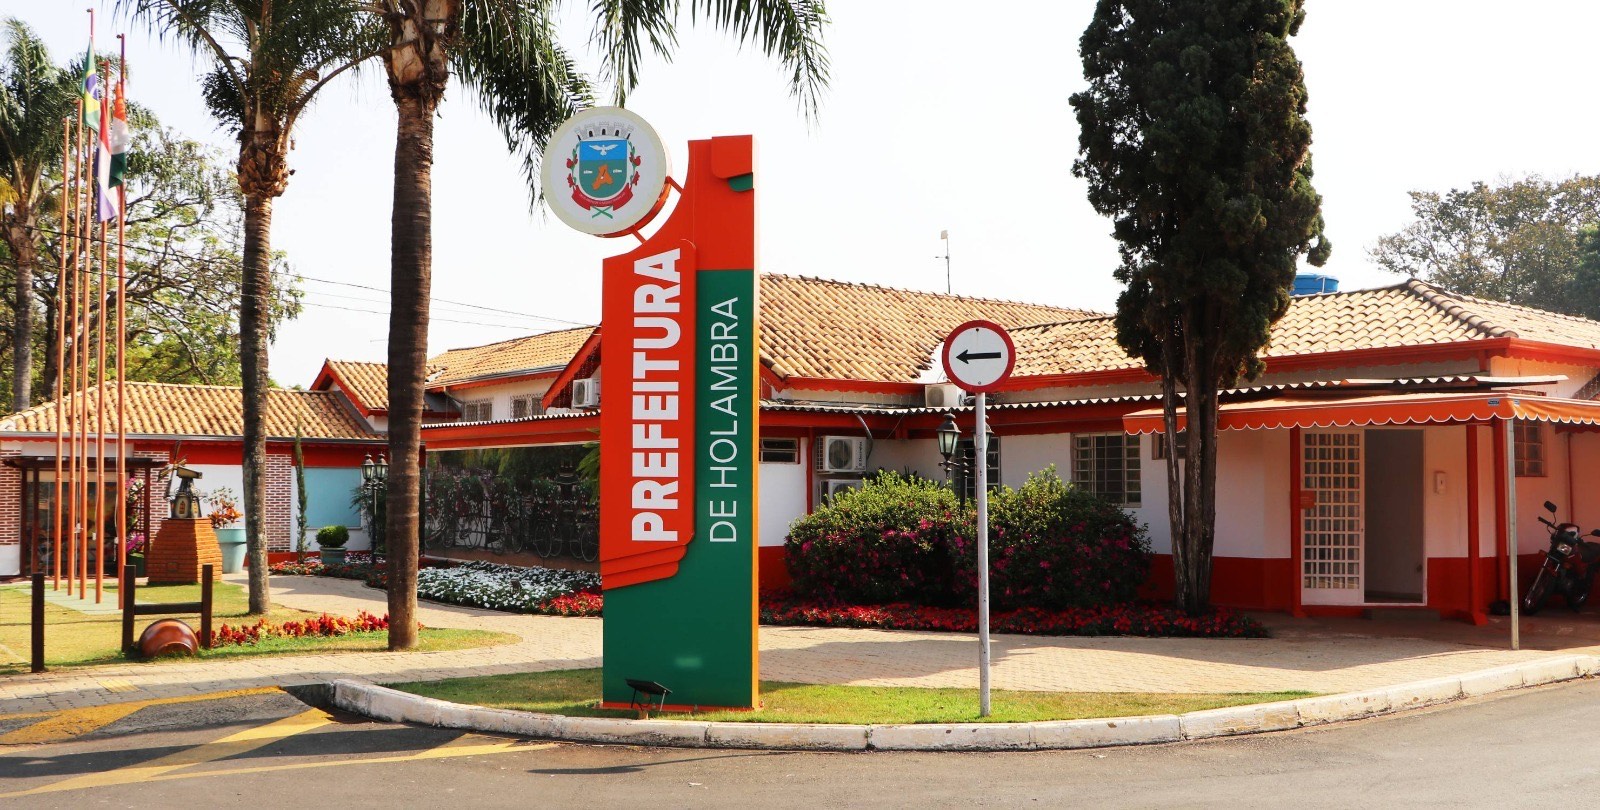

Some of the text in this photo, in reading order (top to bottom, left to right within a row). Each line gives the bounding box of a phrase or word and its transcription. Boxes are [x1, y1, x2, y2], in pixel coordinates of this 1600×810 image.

[631, 247, 682, 542] PREFEITURA
[709, 296, 739, 543] DE HOLAMBRA
